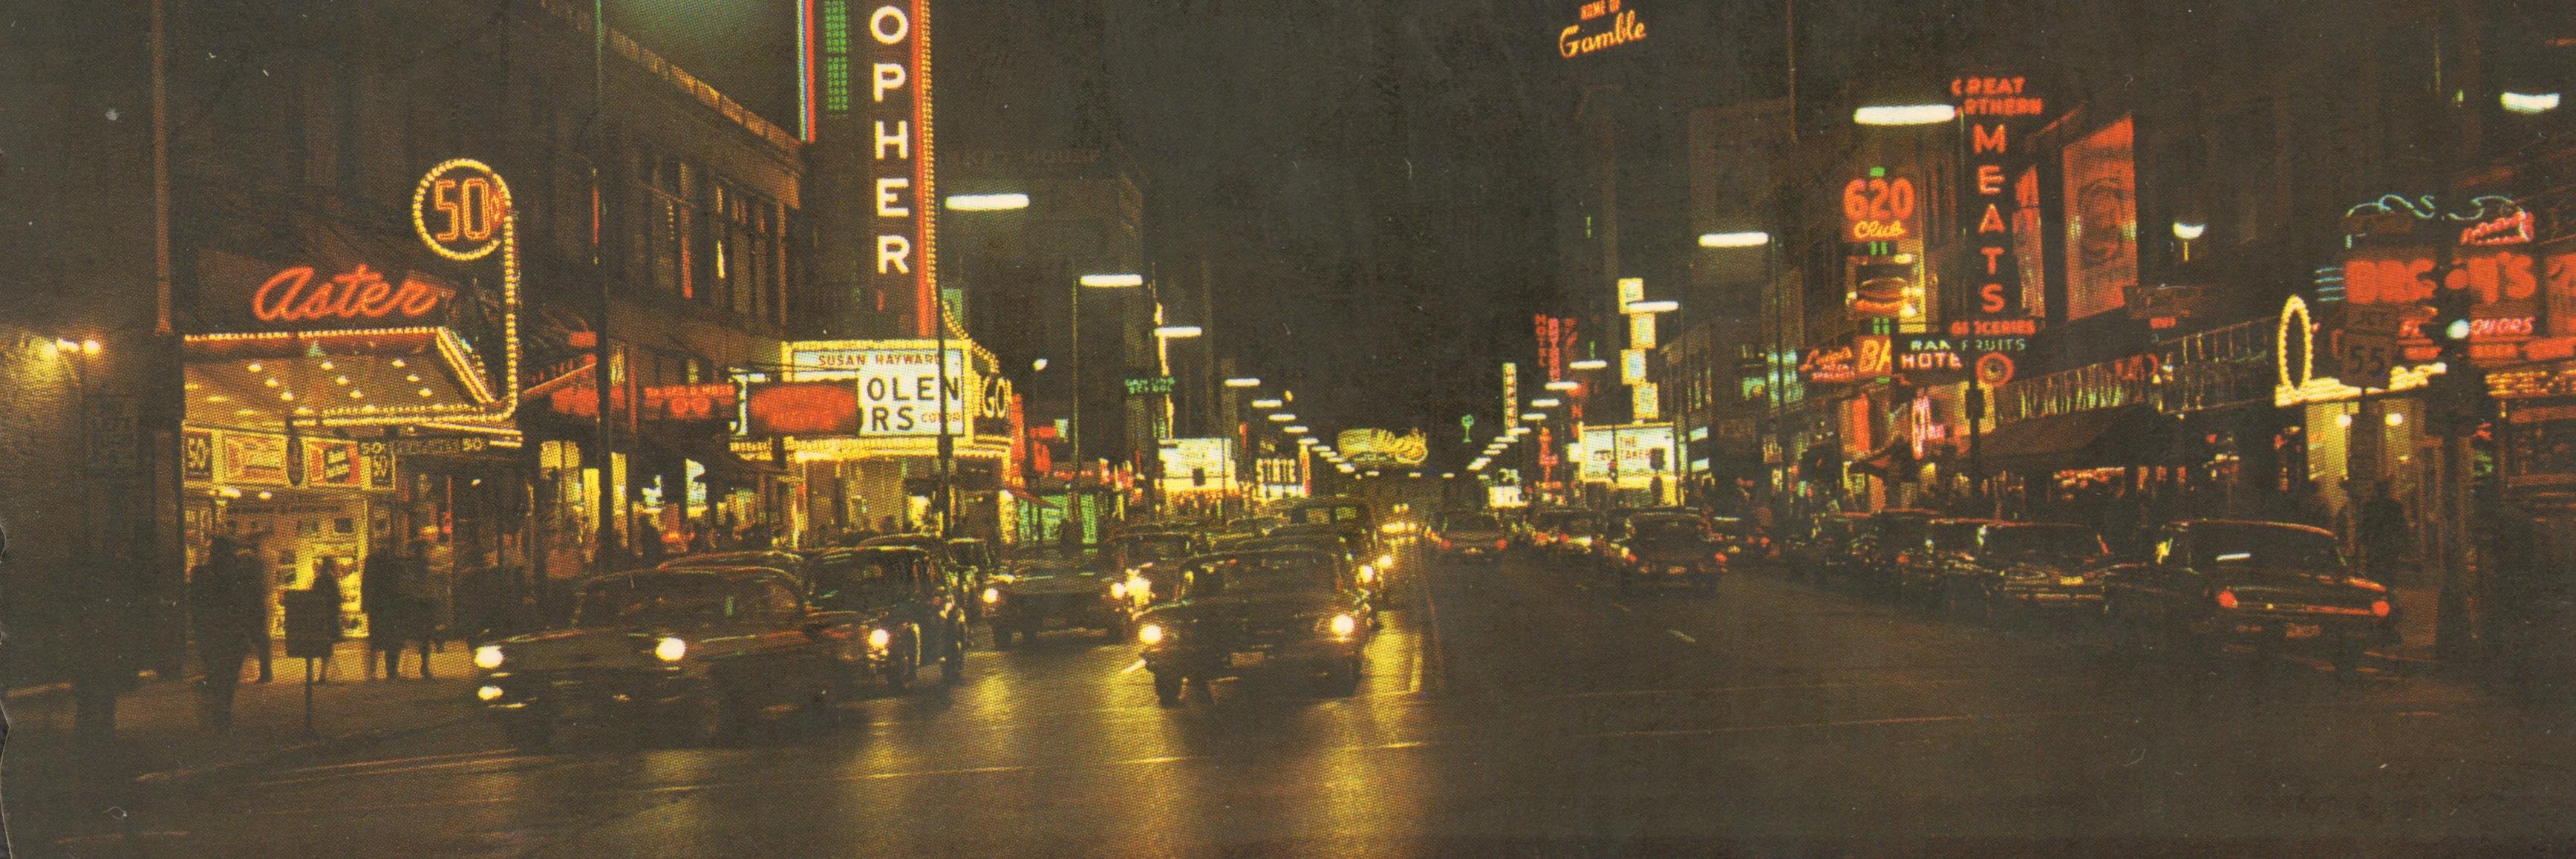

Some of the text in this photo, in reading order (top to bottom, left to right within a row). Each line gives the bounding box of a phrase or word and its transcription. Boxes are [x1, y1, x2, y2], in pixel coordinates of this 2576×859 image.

[1560, 10, 1646, 58] Gamble
[870, 5, 910, 274] OPHER
[1844, 178, 1914, 221] 620
[1972, 123, 2006, 313] MEATS
[1853, 220, 1908, 240] Club
[253, 264, 438, 321] Aster
[818, 352, 866, 366] SUSAN
[1961, 338, 2026, 352] FRUITS
[2349, 345, 2385, 377] 55
[921, 412, 963, 423] COOR
